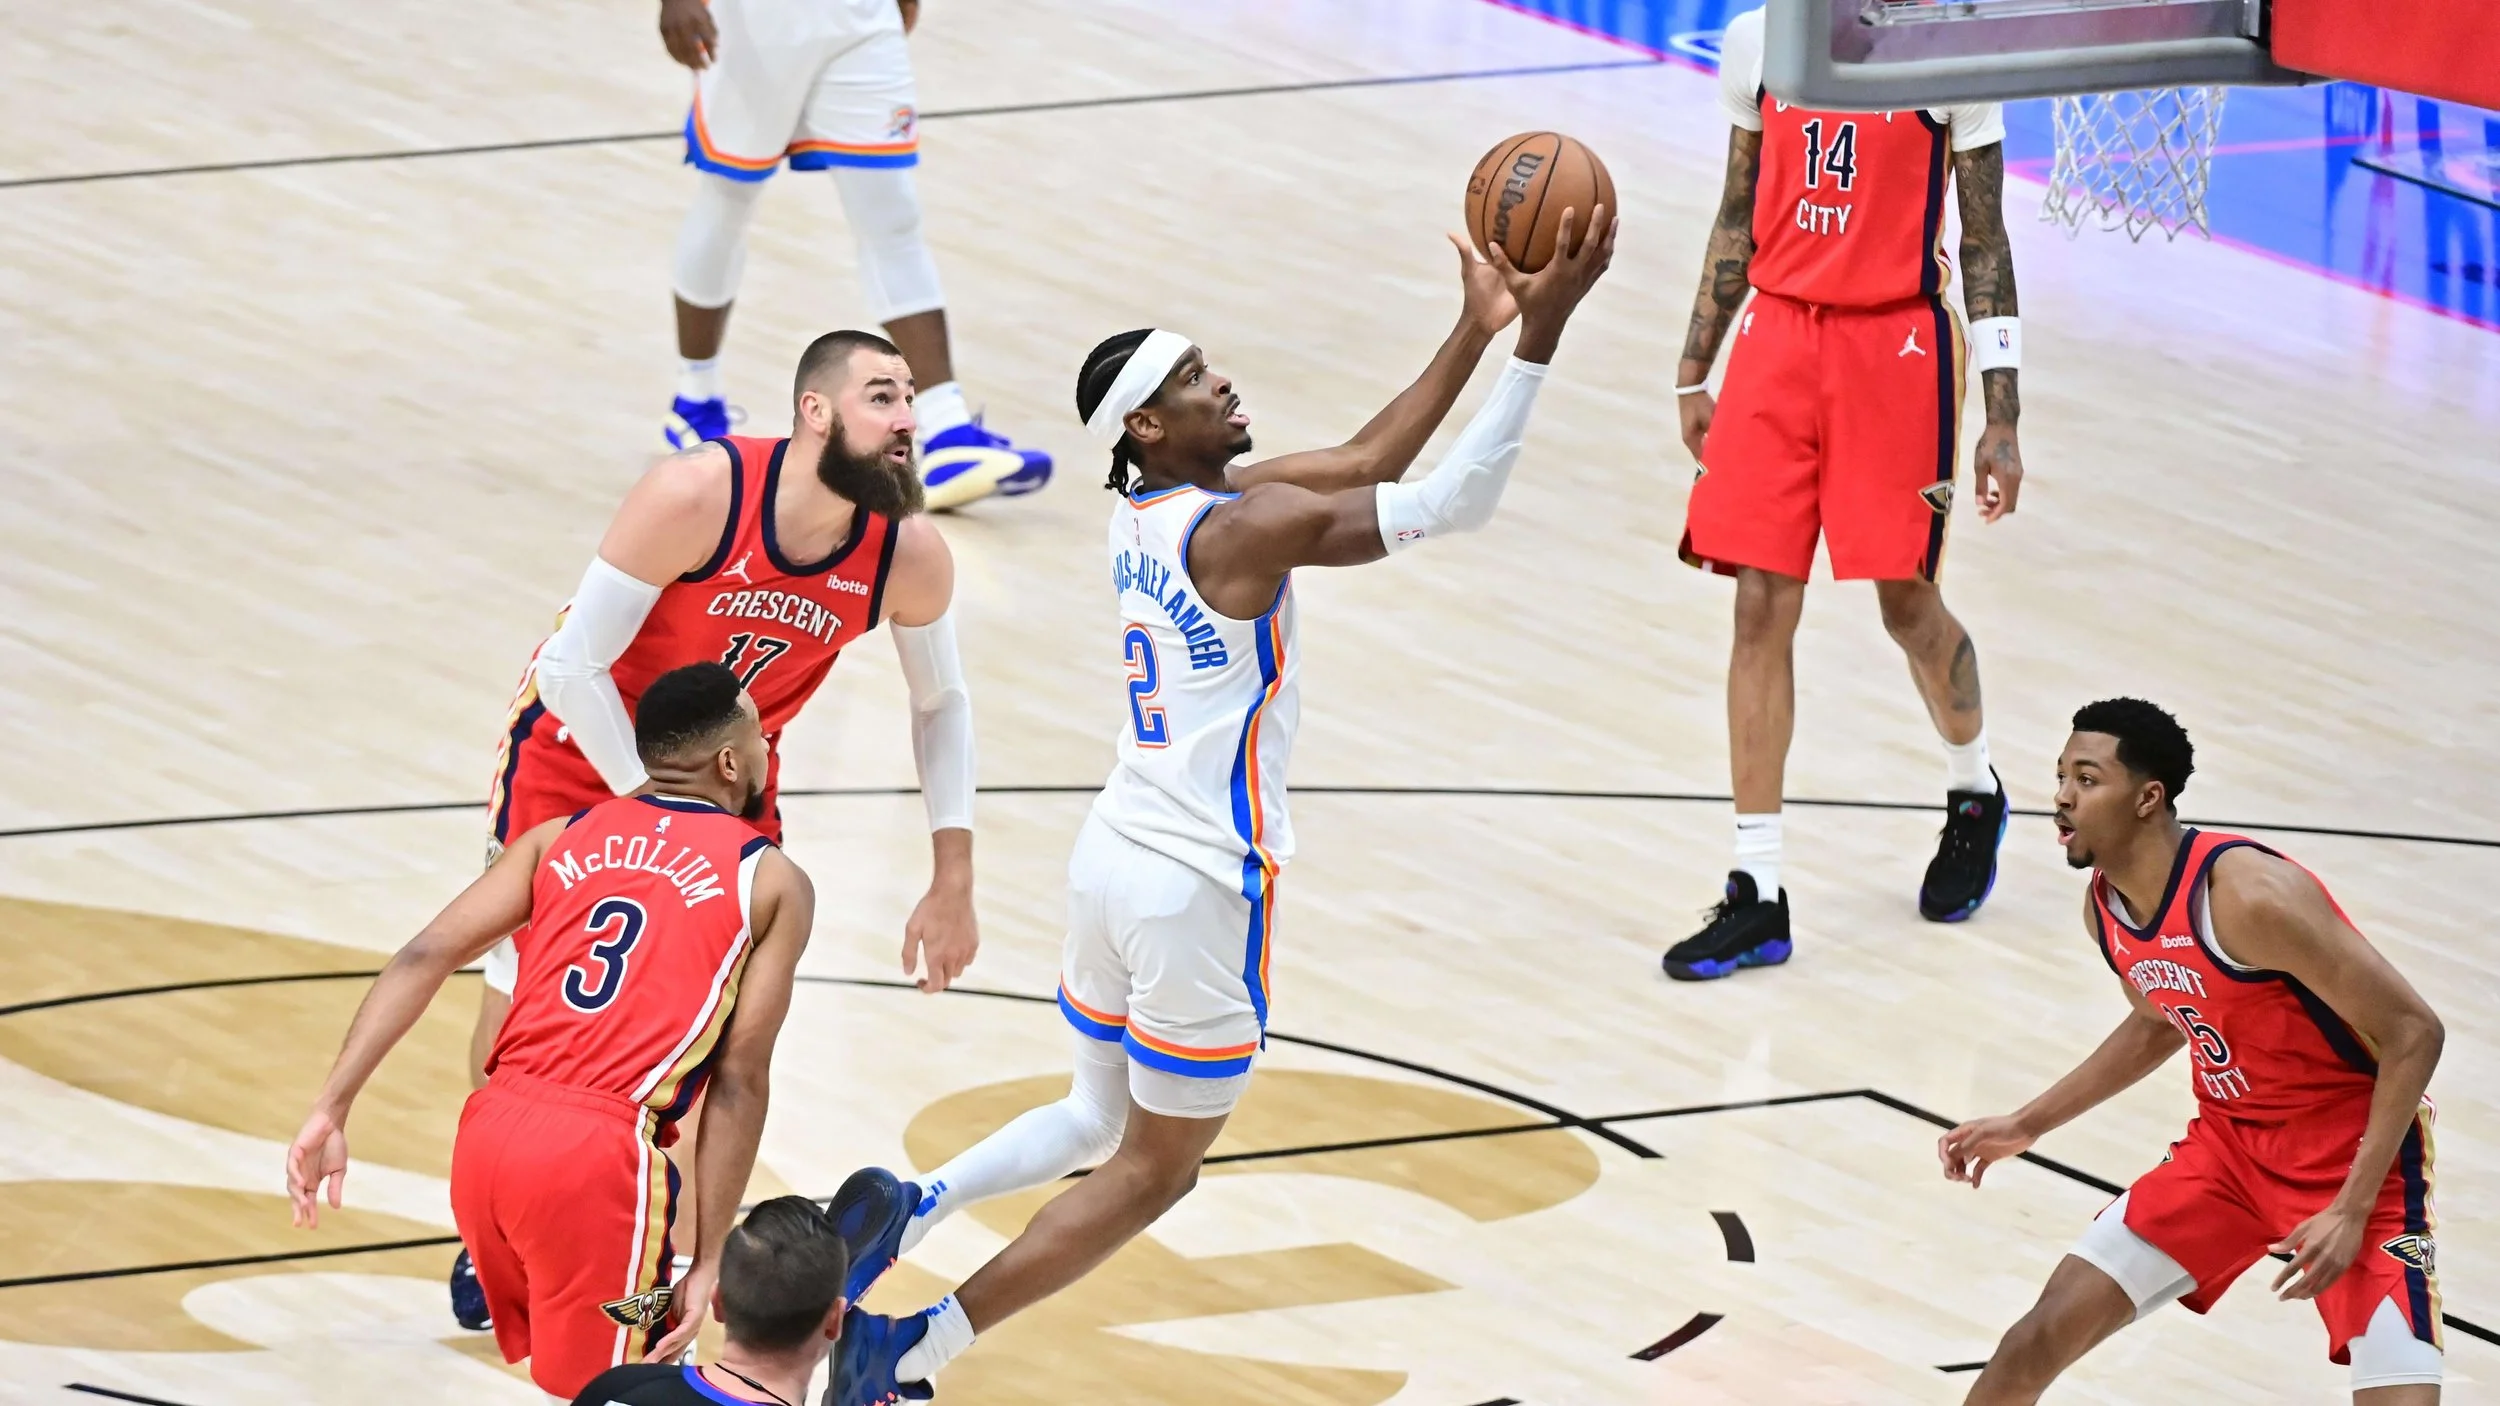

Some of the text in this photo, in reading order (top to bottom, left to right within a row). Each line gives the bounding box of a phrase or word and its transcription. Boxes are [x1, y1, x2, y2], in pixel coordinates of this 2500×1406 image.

[1802, 118, 1858, 192] 14
[1493, 152, 1545, 247] Wilson
[1795, 197, 1853, 236] CITY
[826, 574, 869, 596] ibotta
[1112, 549, 1230, 671] US-ALEXANDER
[706, 590, 843, 645] CRESCENT
[719, 631, 793, 691] 17
[1122, 622, 1172, 750] 2
[548, 835, 725, 909] McCOLLUM
[560, 896, 648, 1014] 3
[2159, 934, 2195, 950] ibotta
[2127, 959, 2208, 999] CRESCENT
[2200, 1066, 2251, 1101] CITY
